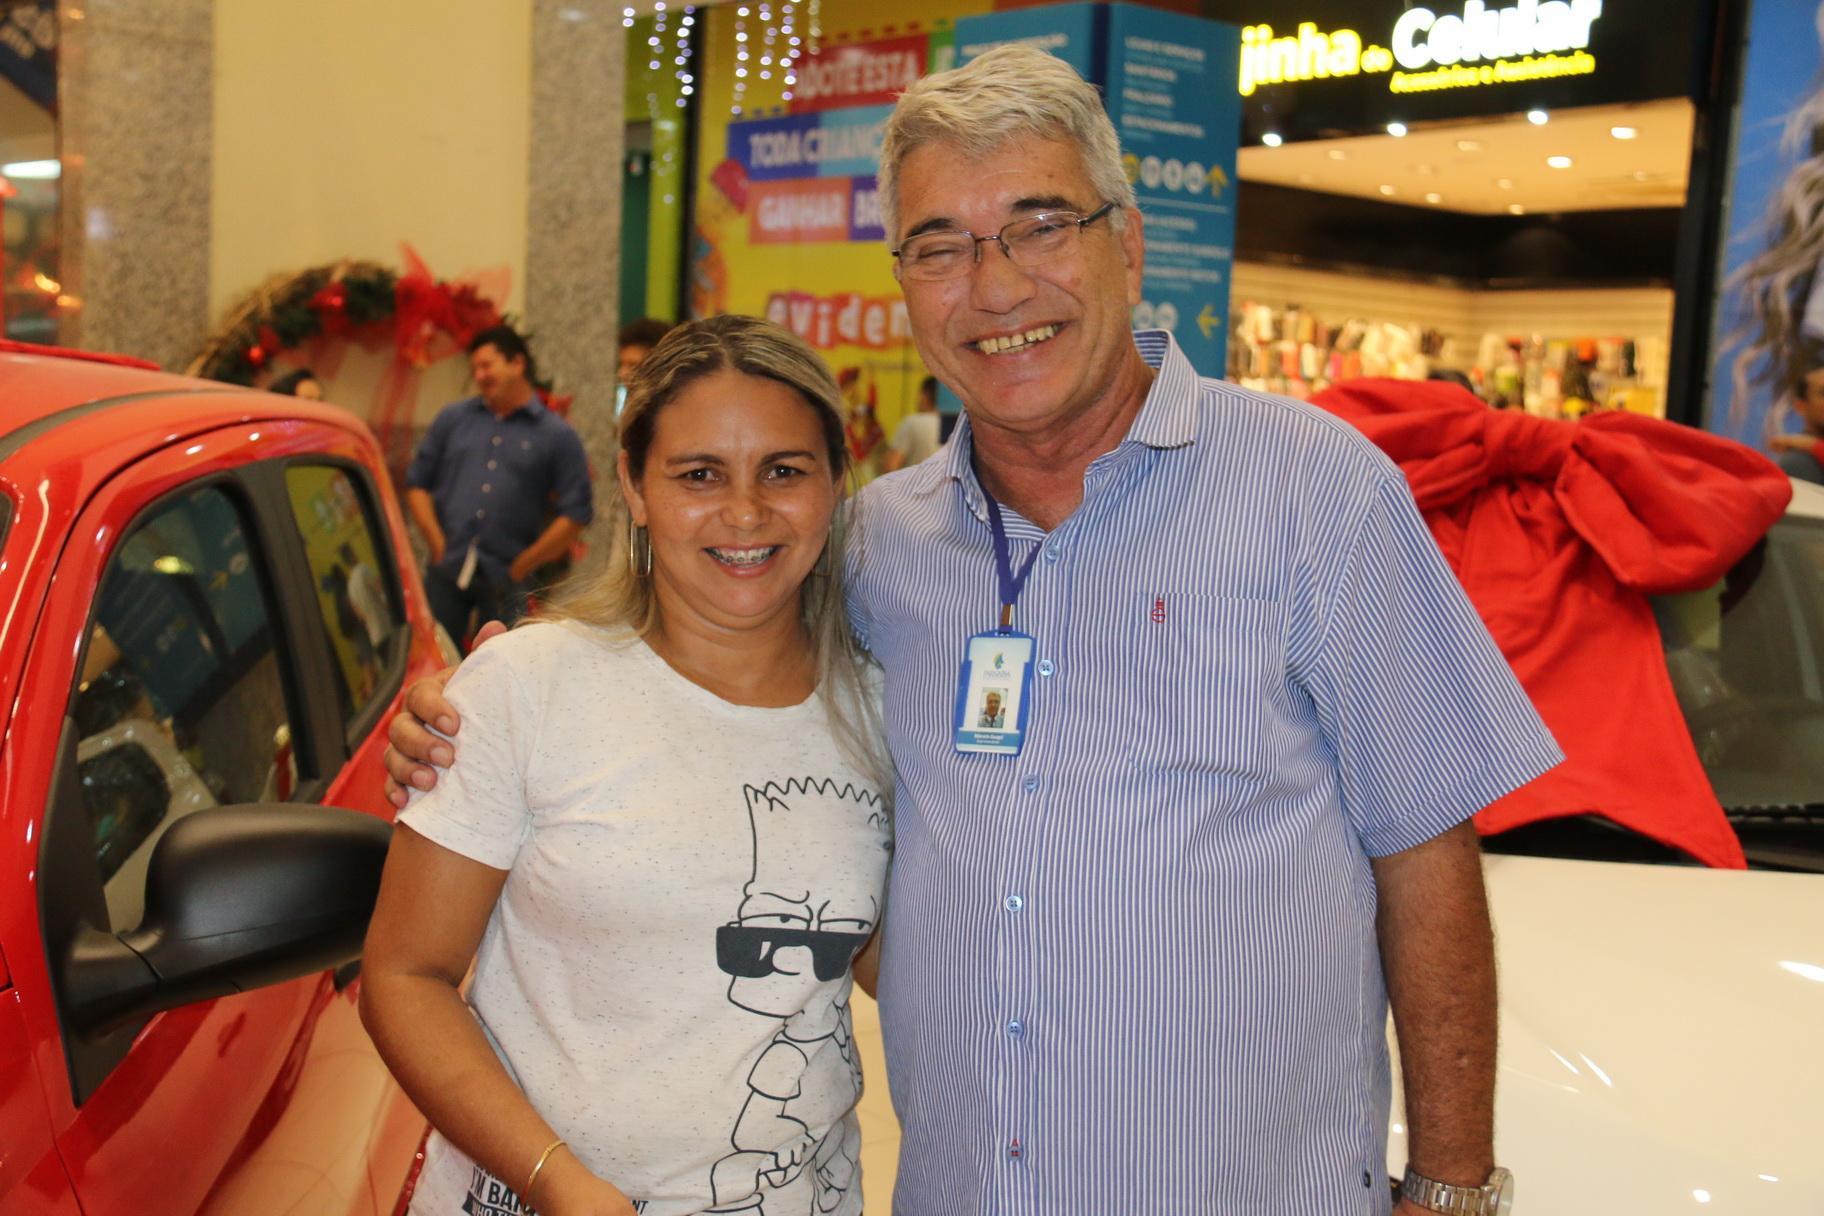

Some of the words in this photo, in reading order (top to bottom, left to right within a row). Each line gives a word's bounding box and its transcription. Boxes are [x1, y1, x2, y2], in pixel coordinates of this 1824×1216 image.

[1239, 22, 1361, 96] jinha
[1392, 0, 1601, 69] Celular
[750, 130, 801, 168] TODA
